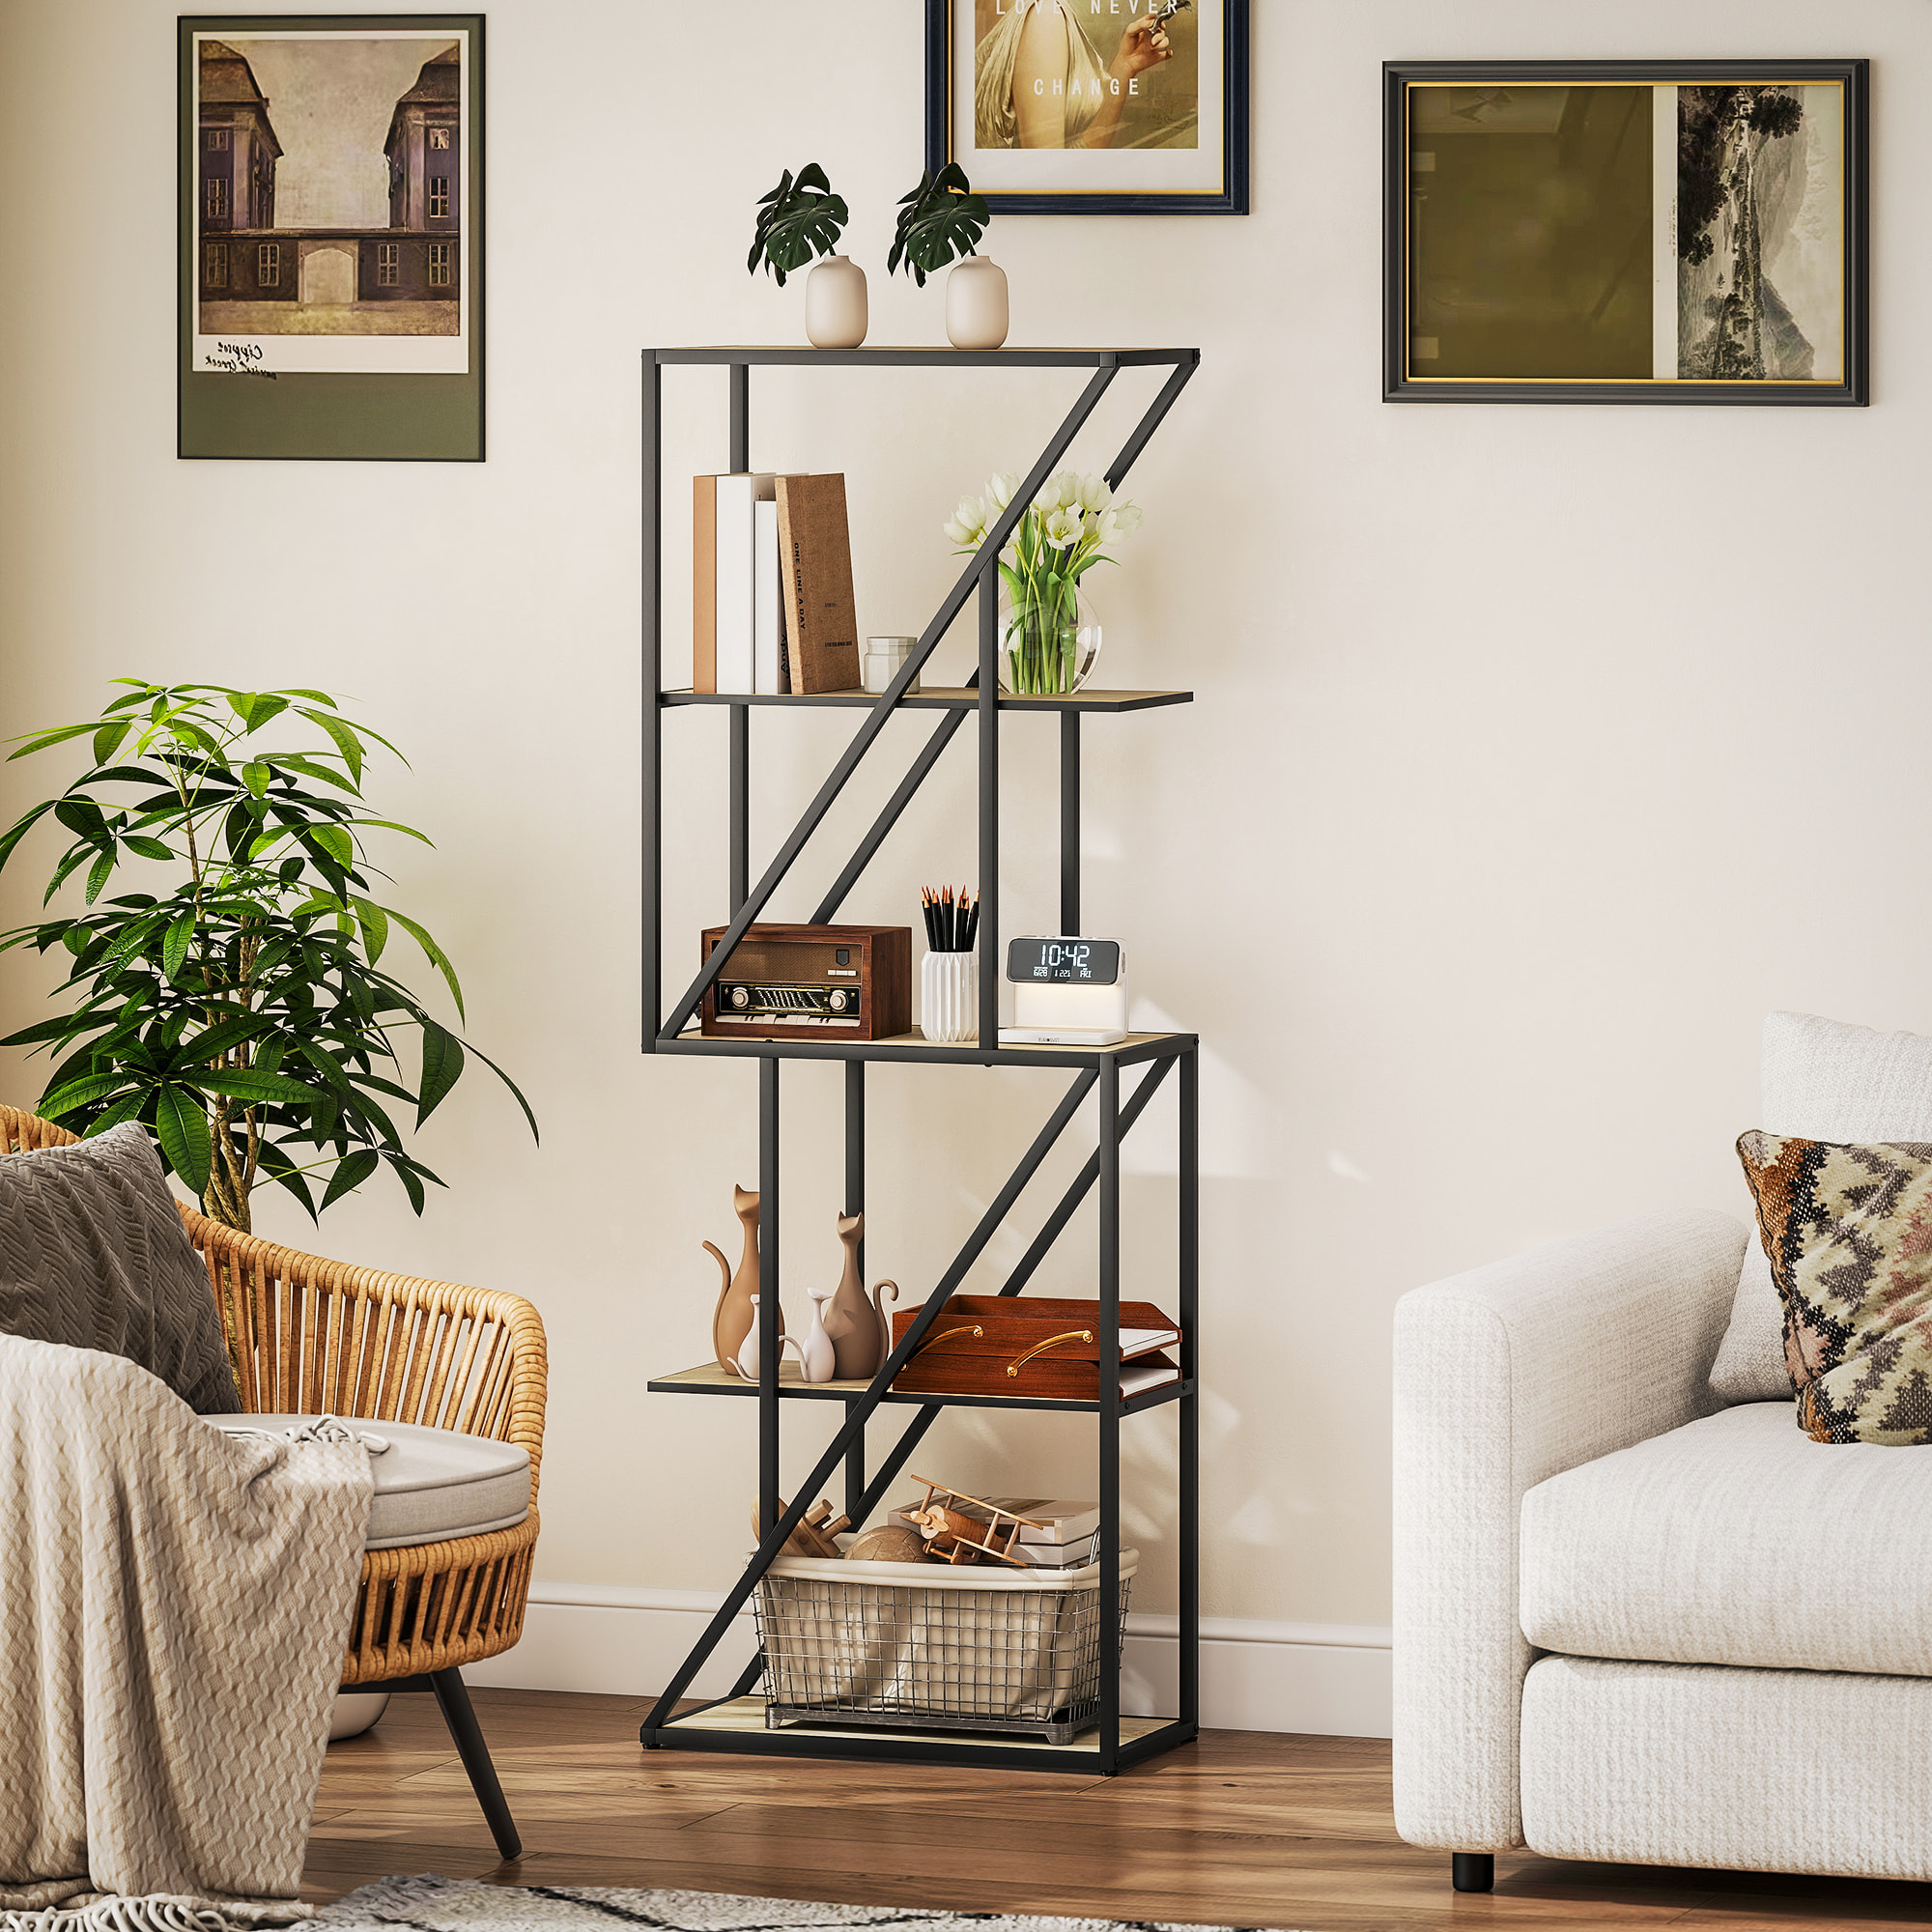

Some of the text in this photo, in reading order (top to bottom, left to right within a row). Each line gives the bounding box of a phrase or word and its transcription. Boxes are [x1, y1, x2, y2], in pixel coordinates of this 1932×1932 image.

[996, 0, 1178, 14] LOVE NEVER
[1034, 78, 1139, 96] CHANGE
[1041, 944, 1091, 968] 10:42
